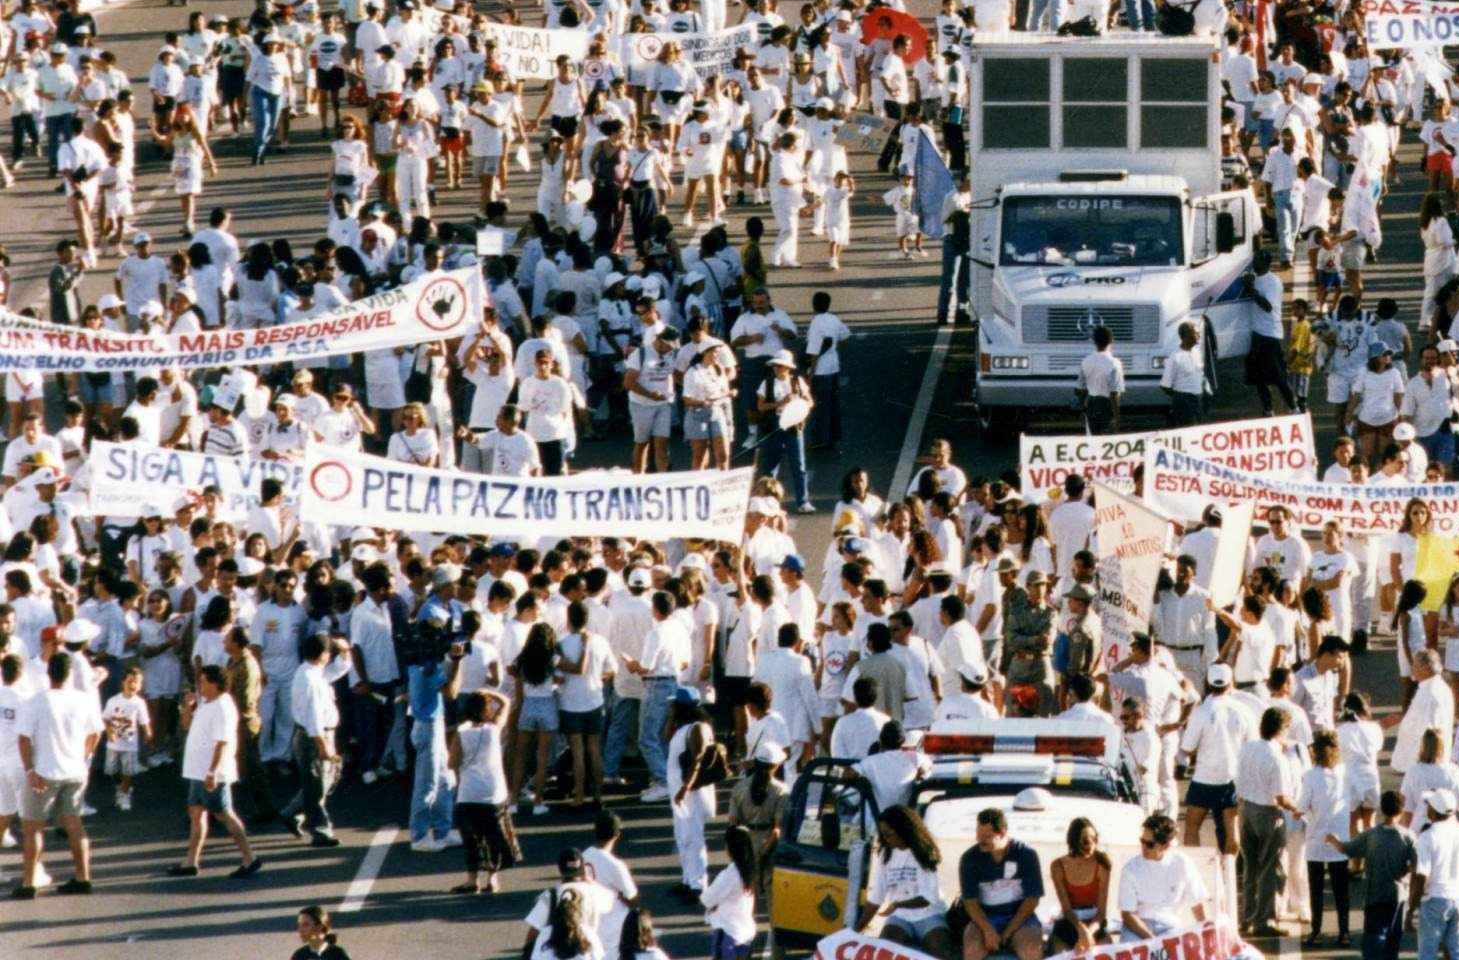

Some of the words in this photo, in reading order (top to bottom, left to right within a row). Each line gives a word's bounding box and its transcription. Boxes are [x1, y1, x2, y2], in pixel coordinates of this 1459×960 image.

[1364, 0, 1421, 15] PAZ
[1387, 19, 1404, 43] O
[1057, 198, 1122, 210] CODIPE
[180, 331, 245, 352] MAIS
[0, 354, 86, 370] ONSELHO
[245, 345, 273, 361] DA
[286, 339, 330, 357] ASA
[1029, 444, 1046, 464] A
[1101, 438, 1146, 461] 204
[1201, 426, 1283, 452] CONTRA
[1289, 423, 1304, 443] A
[1155, 449, 1169, 469] A
[106, 447, 184, 485] SIGA
[198, 456, 222, 494] A
[362, 468, 442, 516] PELA
[451, 477, 519, 519] PAZ
[524, 485, 557, 520] NO
[564, 484, 711, 522] TRANSITO
[1306, 496, 1344, 512] COM
[1351, 500, 1364, 514] A
